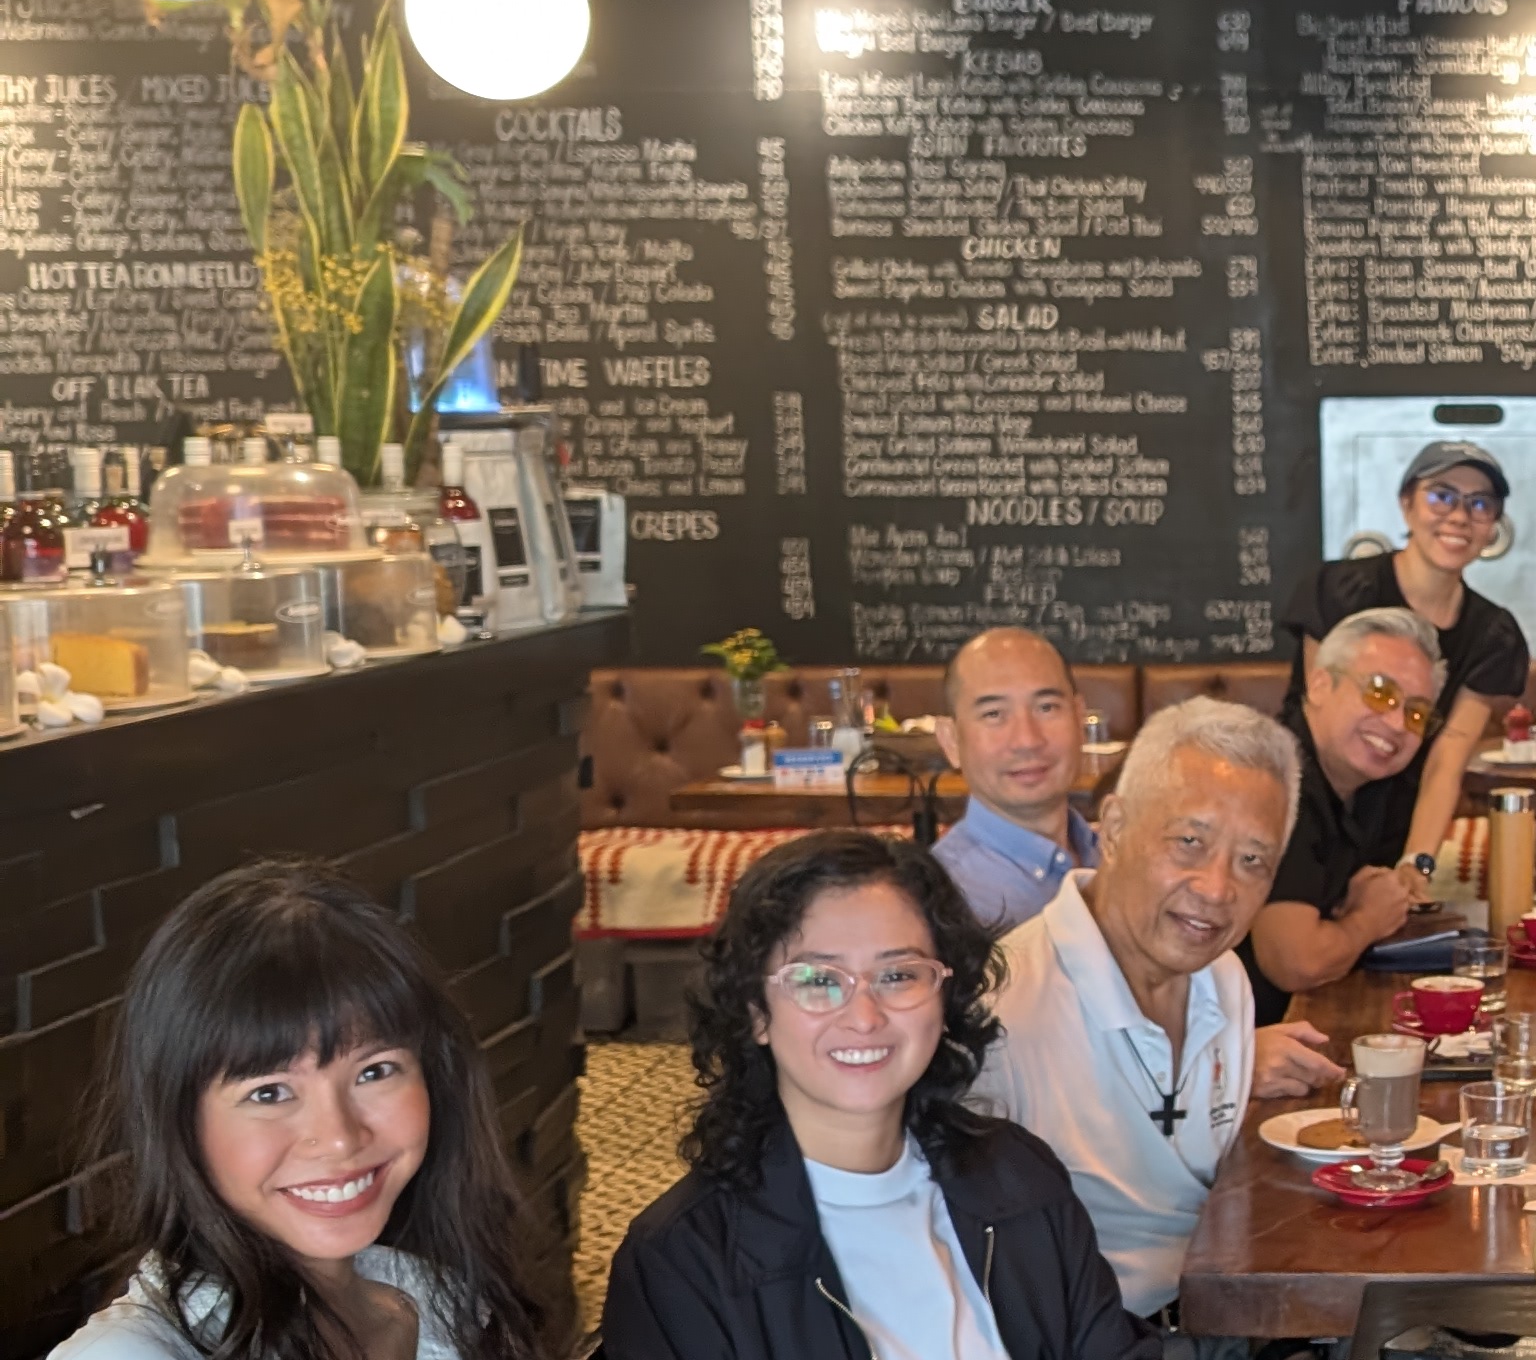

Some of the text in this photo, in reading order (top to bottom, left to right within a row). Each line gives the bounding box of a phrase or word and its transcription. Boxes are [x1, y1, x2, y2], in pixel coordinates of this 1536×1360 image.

[496, 106, 622, 141] COCKTAILS
[962, 235, 1061, 259] CHICKEN
[28, 262, 77, 290] HOT
[83, 261, 131, 290] TEA
[977, 303, 1059, 330] SALAD
[605, 356, 711, 388] WAFFLES
[52, 373, 209, 401] OFF TEA
[630, 510, 719, 541] CREPES
[967, 497, 1165, 526] NOODLES SOUP
